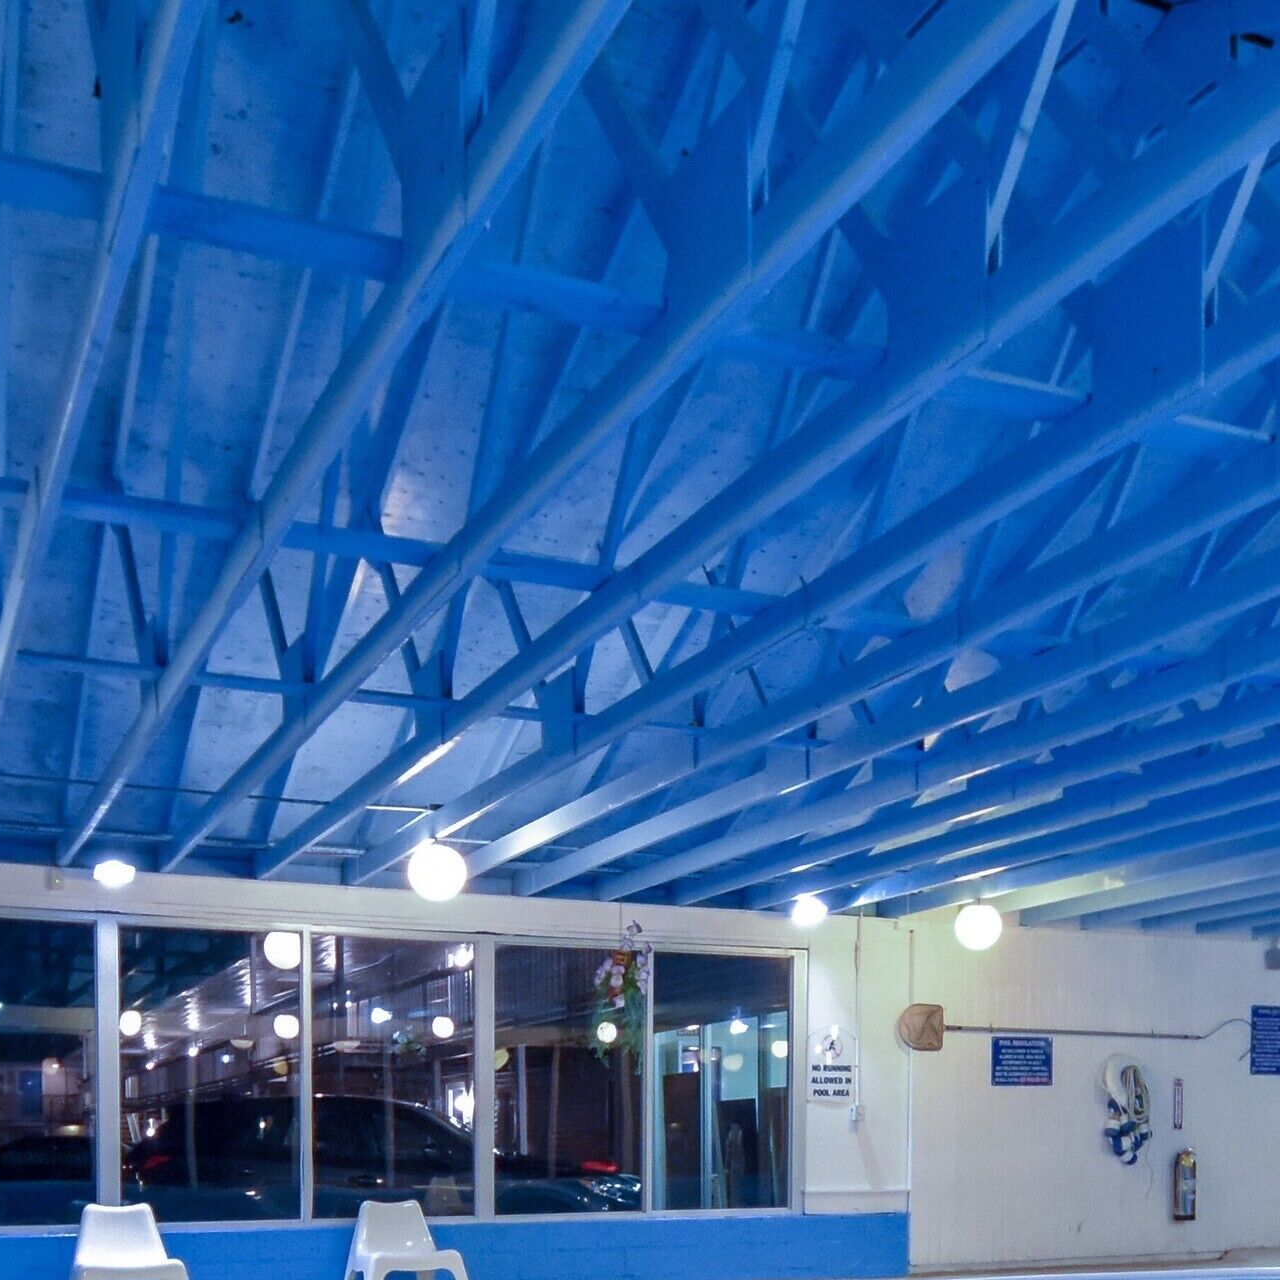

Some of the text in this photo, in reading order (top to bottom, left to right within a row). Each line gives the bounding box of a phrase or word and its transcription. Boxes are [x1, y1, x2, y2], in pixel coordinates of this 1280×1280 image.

[811, 1064, 852, 1072] NO RUNNING
[811, 1076, 843, 1085] ALLOWED
[813, 1089, 850, 1097] POOL AREA
